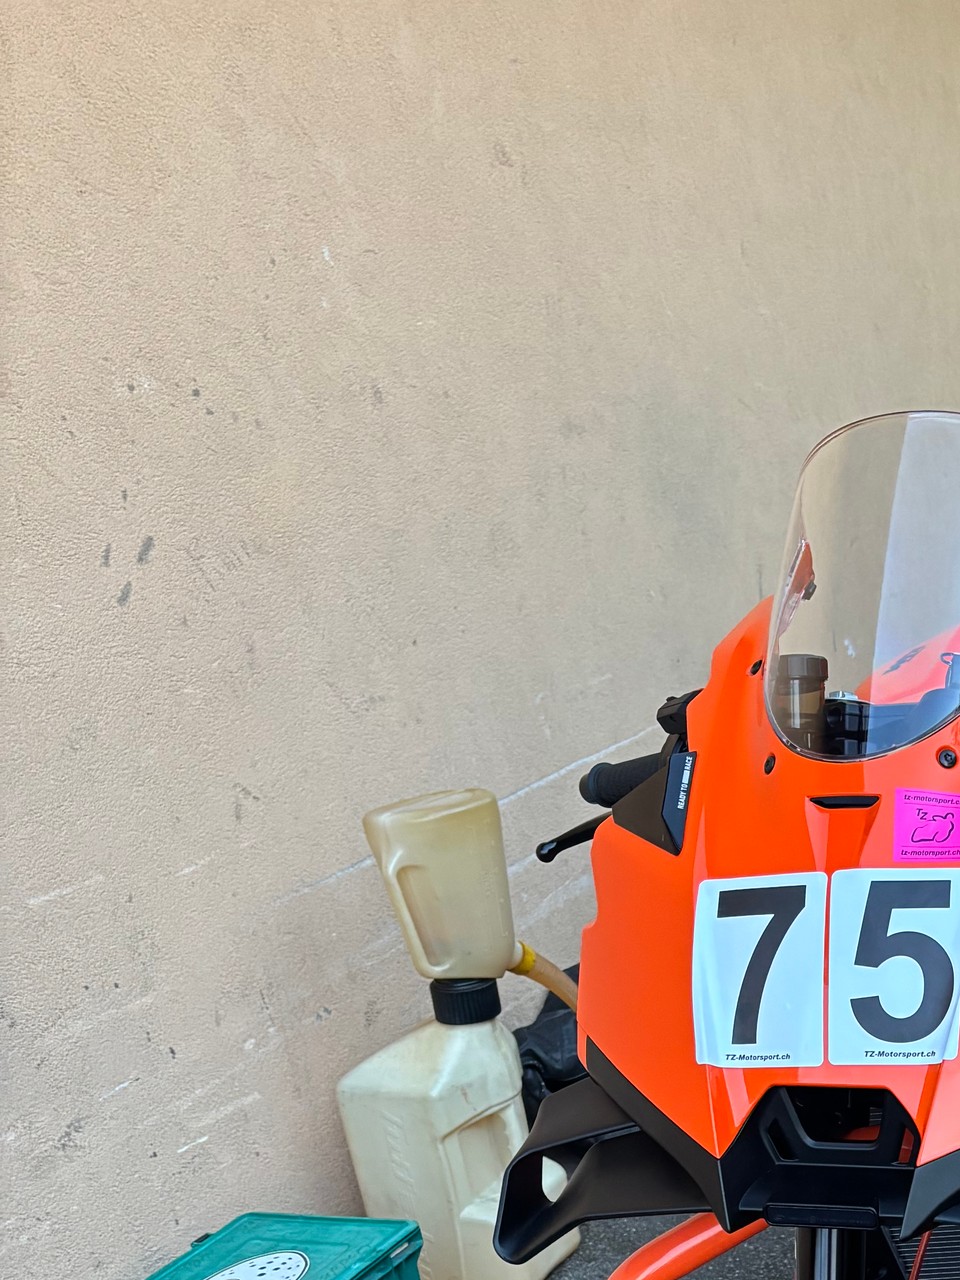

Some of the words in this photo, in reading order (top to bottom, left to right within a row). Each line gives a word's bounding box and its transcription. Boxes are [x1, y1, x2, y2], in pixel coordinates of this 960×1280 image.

[684, 756, 693, 770] RACE
[680, 783, 688, 791] TO
[677, 790, 687, 810] READY
[916, 808, 928, 820] TZ
[901, 849, 960, 857] tz-motorsport.ch
[725, 1053, 791, 1061] TZ-Motorsport.ch
[864, 1050, 936, 1059] TZ-Motorsport.ch
